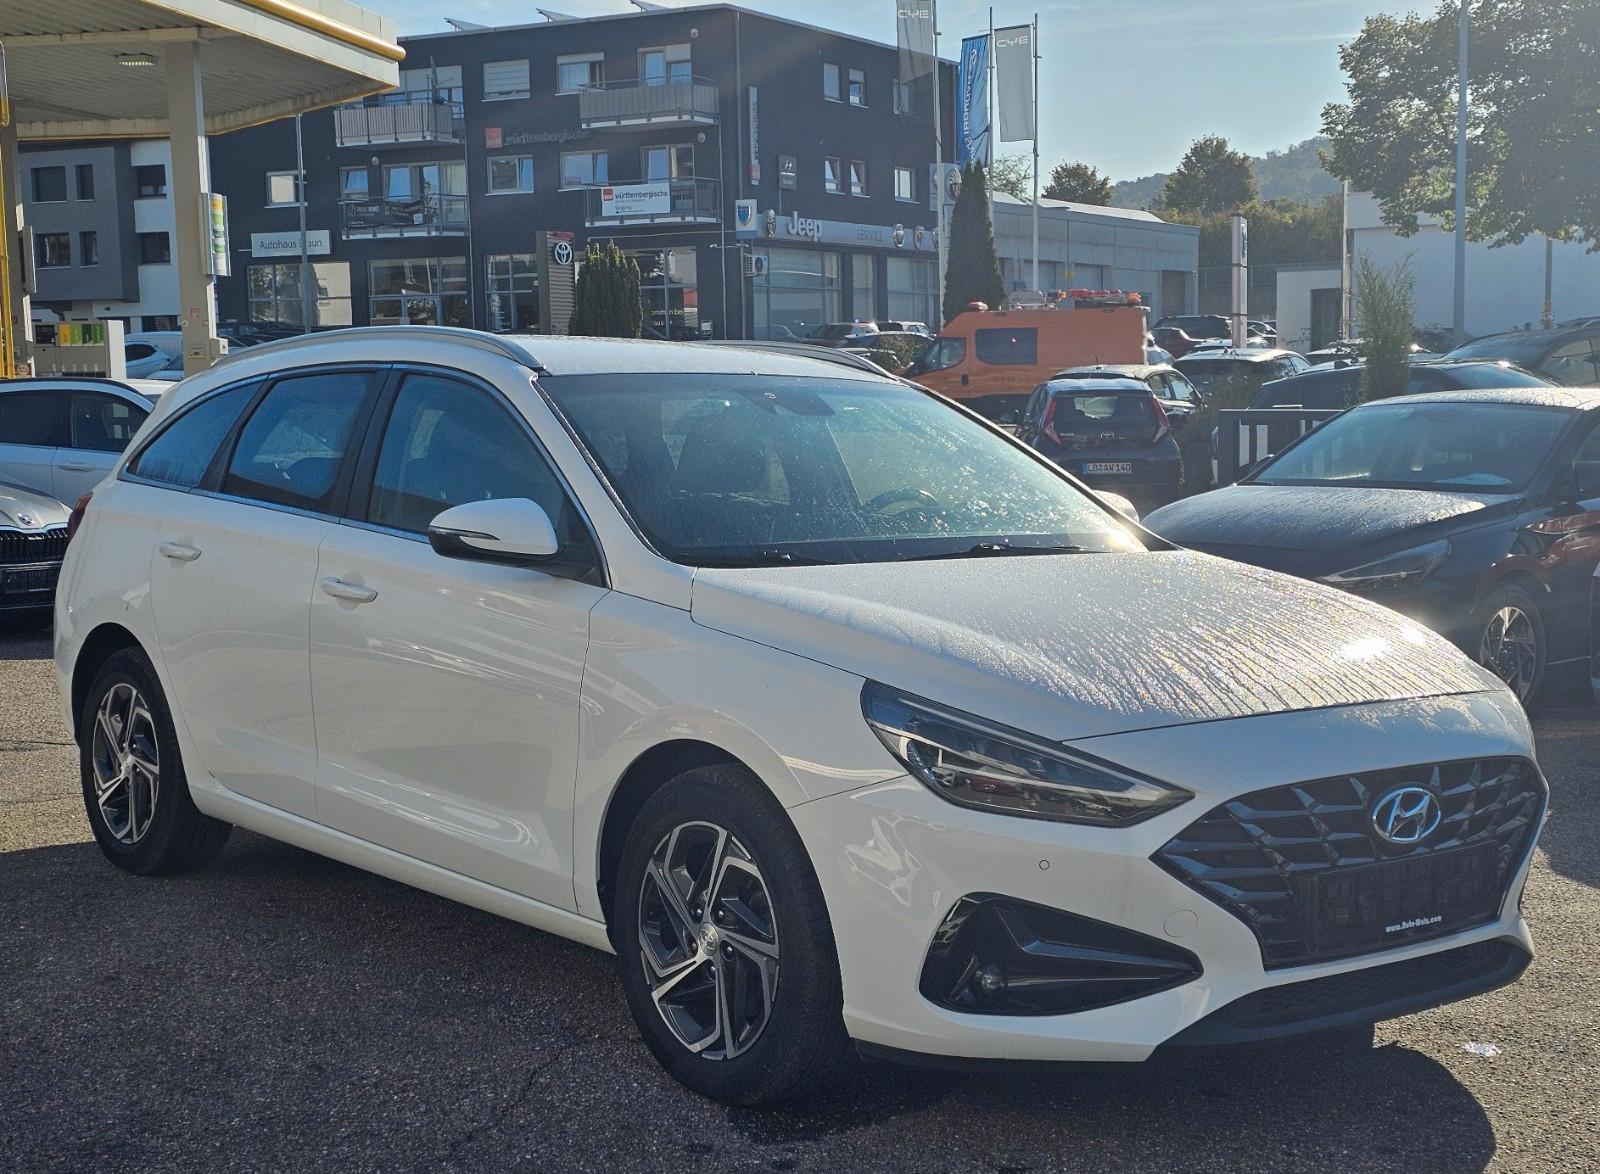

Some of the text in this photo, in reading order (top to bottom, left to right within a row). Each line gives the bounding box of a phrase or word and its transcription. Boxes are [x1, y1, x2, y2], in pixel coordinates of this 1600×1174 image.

[788, 211, 822, 242] Jeep
[857, 228, 883, 242] SERVICE
[260, 240, 297, 250] Autohaus
[1116, 463, 1131, 472] 140
